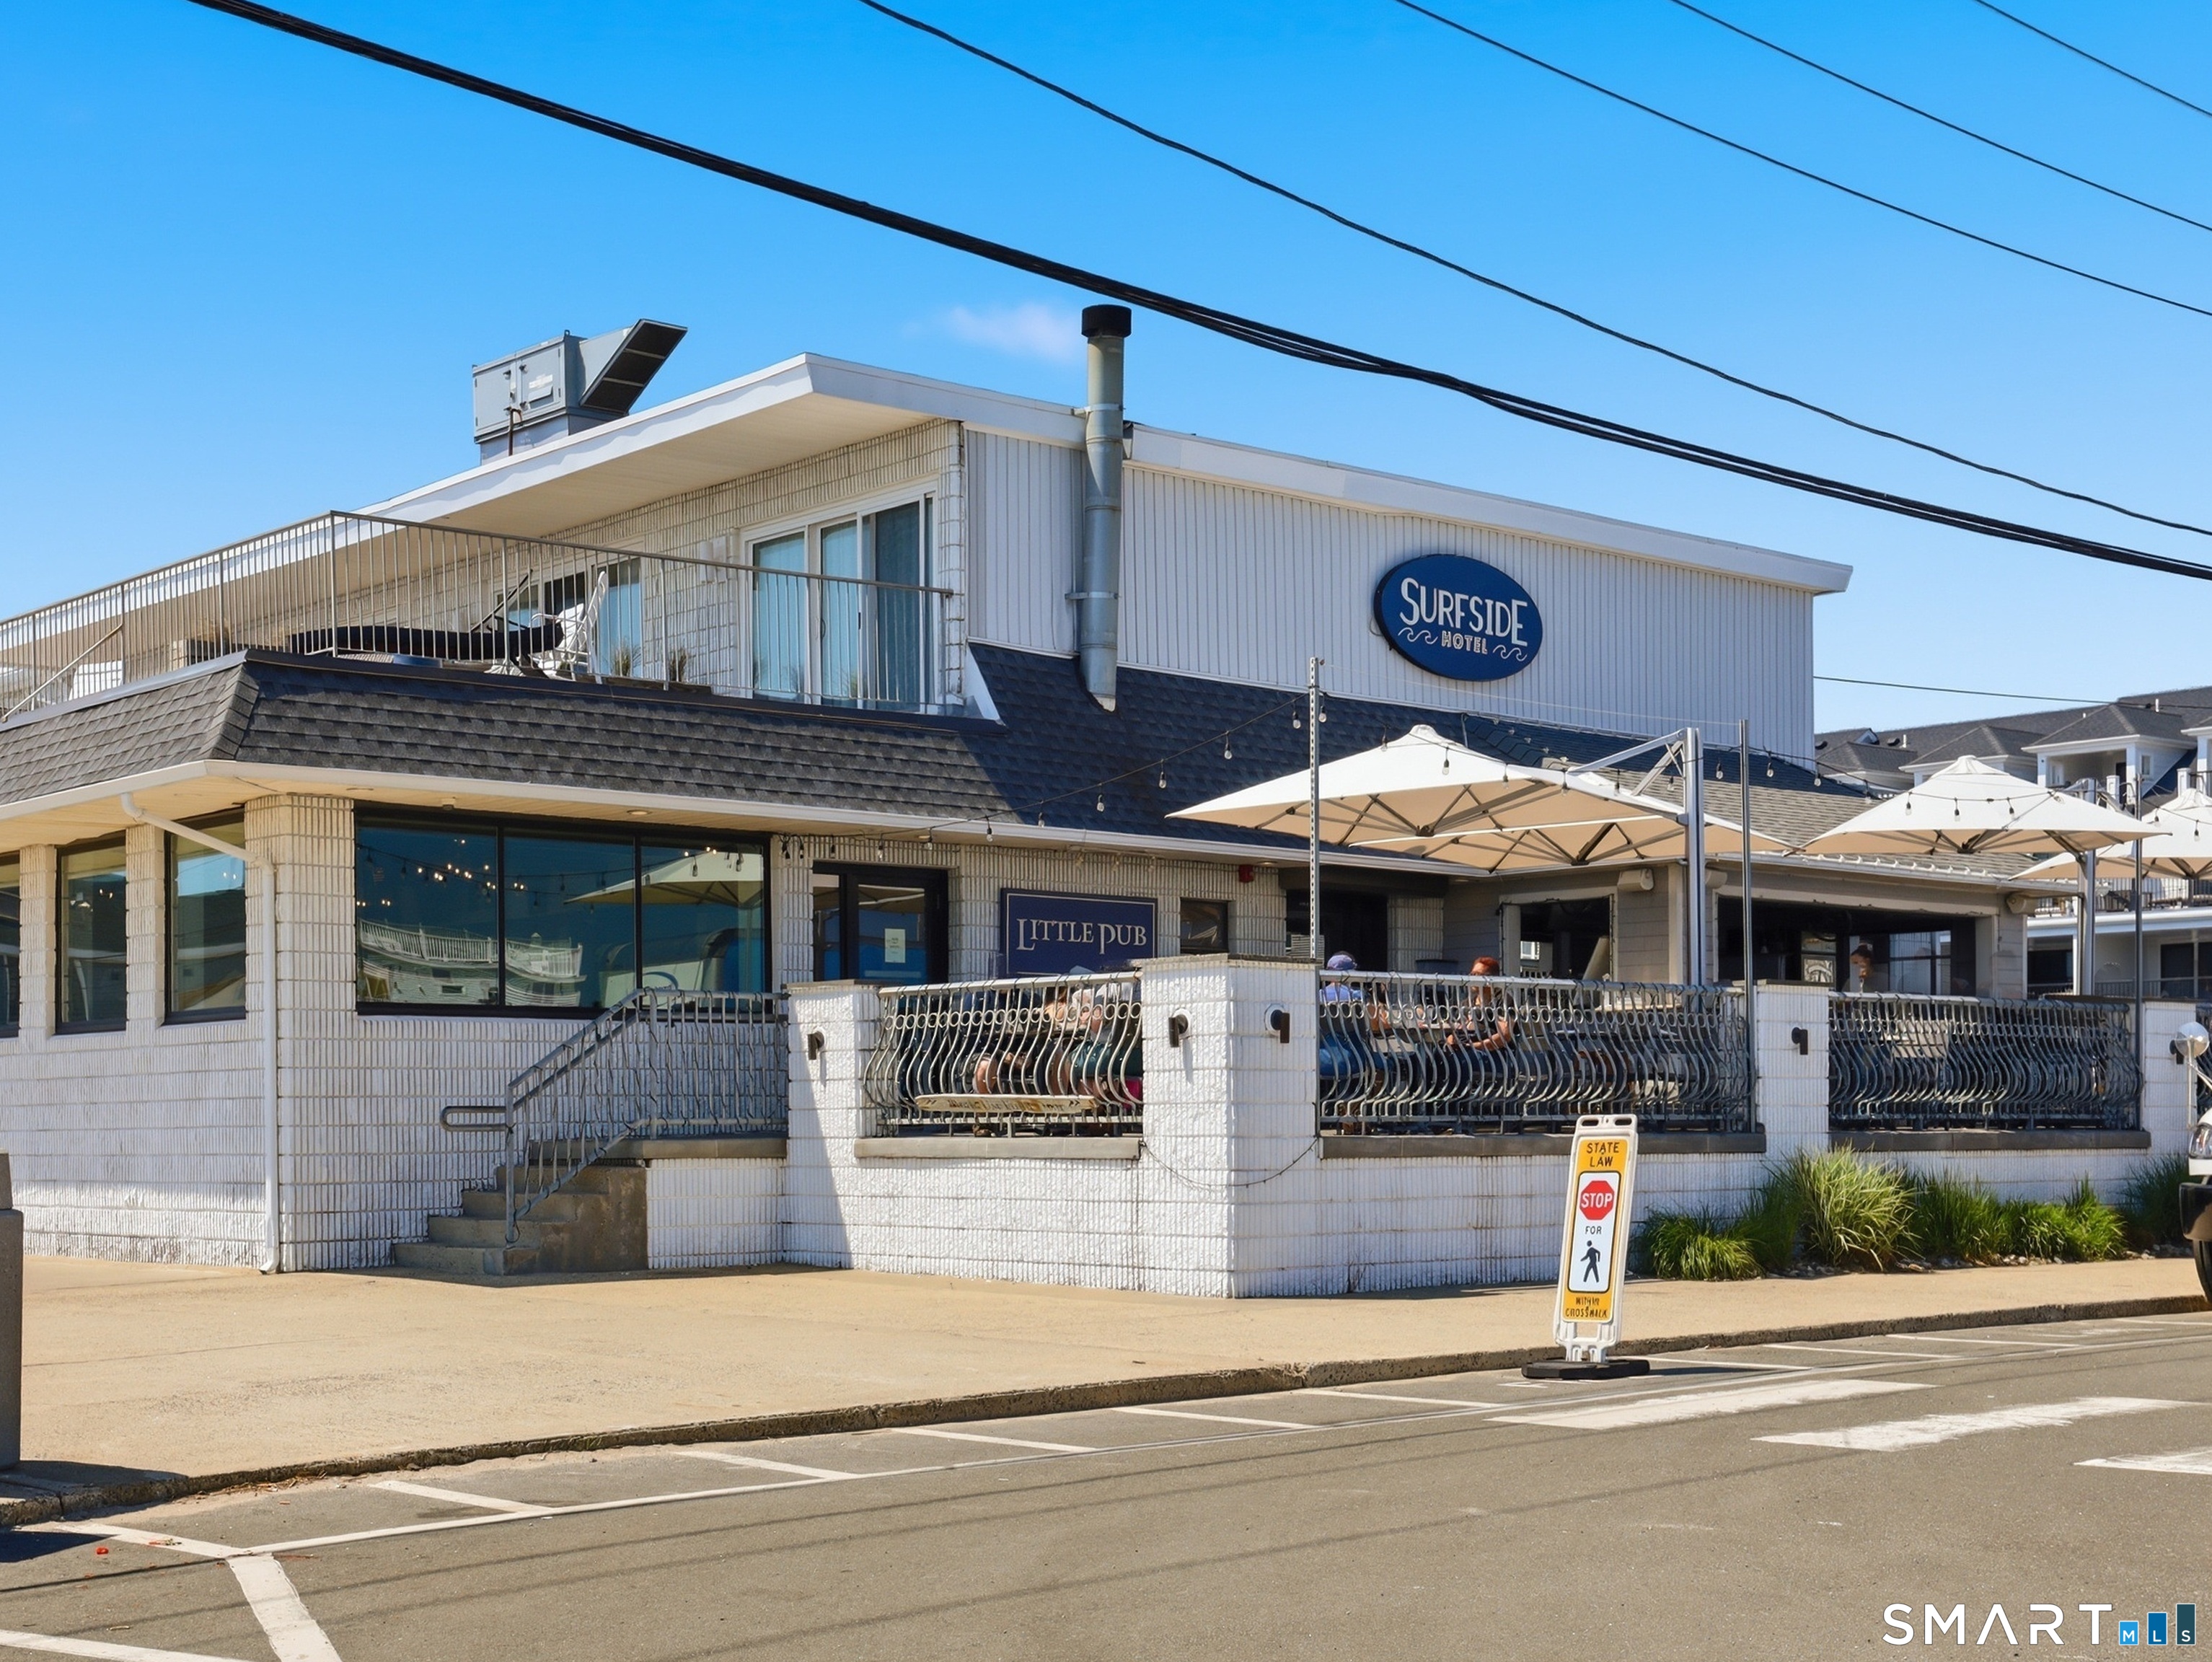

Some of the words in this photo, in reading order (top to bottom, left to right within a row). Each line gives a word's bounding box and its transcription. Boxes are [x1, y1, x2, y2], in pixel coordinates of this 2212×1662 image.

[1399, 577, 1528, 646] SURFSIDE
[1441, 630, 1488, 654] HOTEL
[1015, 918, 1094, 951] LITTLE
[1097, 923, 1147, 955] PUB
[1586, 1141, 1620, 1154] STATE
[1589, 1156, 1613, 1168] LAW
[1581, 1192, 1613, 1208] STOP
[1585, 1225, 1603, 1235] FOR
[1565, 1307, 1608, 1318] CROSSWALK
